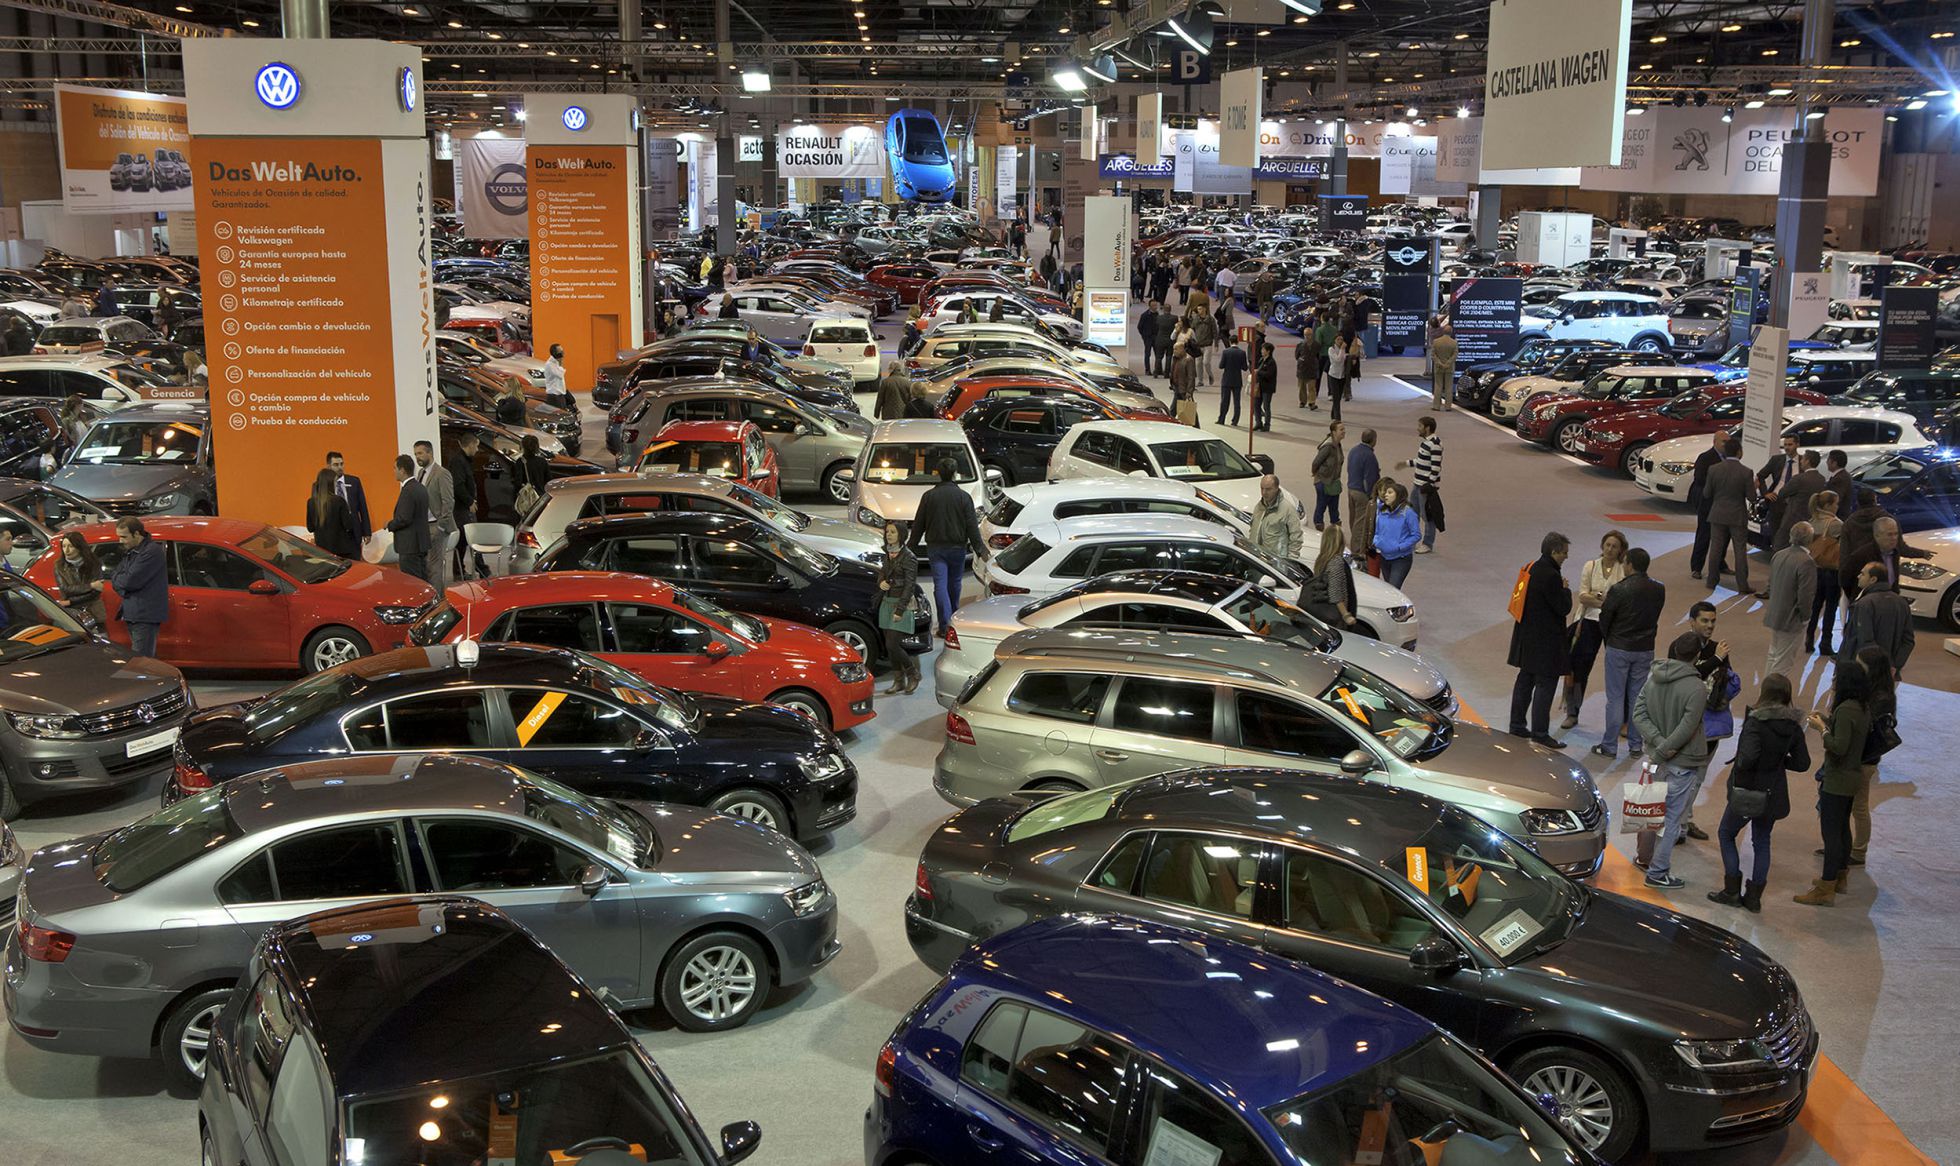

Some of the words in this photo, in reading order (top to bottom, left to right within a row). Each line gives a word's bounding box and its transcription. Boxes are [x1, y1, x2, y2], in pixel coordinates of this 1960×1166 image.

[1181, 51, 1200, 79] B
[1492, 60, 1557, 98] CASTELLANA
[1562, 49, 1610, 87] WAGEN
[786, 137, 842, 150] RENAULT
[1260, 134, 1281, 145] On
[1303, 134, 1334, 145] Driv
[1345, 134, 1366, 145] On
[786, 151, 843, 166] OCASIÓN
[210, 161, 362, 182] DasWeltAuto.
[1744, 161, 1778, 172] DEL
[211, 188, 250, 197] Vehículos
[252, 188, 262, 197] de
[266, 188, 300, 197] Ocasión
[302, 189, 312, 197] de
[489, 186, 528, 194] VOLV
[236, 225, 275, 234] Revisión
[278, 225, 326, 234] certificada
[238, 236, 293, 246] Volkswagen
[238, 250, 280, 258] Garantía
[282, 252, 318, 260] europea
[321, 250, 347, 258] hasta
[239, 260, 252, 269] 24
[254, 261, 282, 269] meses
[240, 274, 276, 283] Servicio
[278, 274, 290, 283] de
[292, 274, 336, 283] asistencia
[241, 284, 281, 294] personal
[242, 298, 294, 308] Kilometraje
[297, 298, 344, 307] certificado
[244, 322, 277, 332] Opción
[279, 322, 312, 331] cambio
[322, 322, 371, 331] devolución
[246, 346, 276, 354] Oferta
[278, 346, 288, 354] de
[291, 346, 346, 354] financiación
[248, 369, 316, 378] Personalización
[318, 369, 332, 378] del
[335, 369, 372, 378] vehículo
[150, 389, 195, 398] Gerencia
[250, 393, 282, 403] Opción
[284, 394, 318, 404] compra
[320, 393, 330, 402] de
[333, 393, 370, 402] vehículo
[258, 404, 292, 412] cambio
[252, 416, 283, 426] Prueba
[285, 416, 296, 425] de
[298, 416, 348, 426] conducción
[528, 704, 550, 727] Diesel
[1412, 853, 1423, 882] Gerencia
[1500, 929, 1521, 946] 40.000
